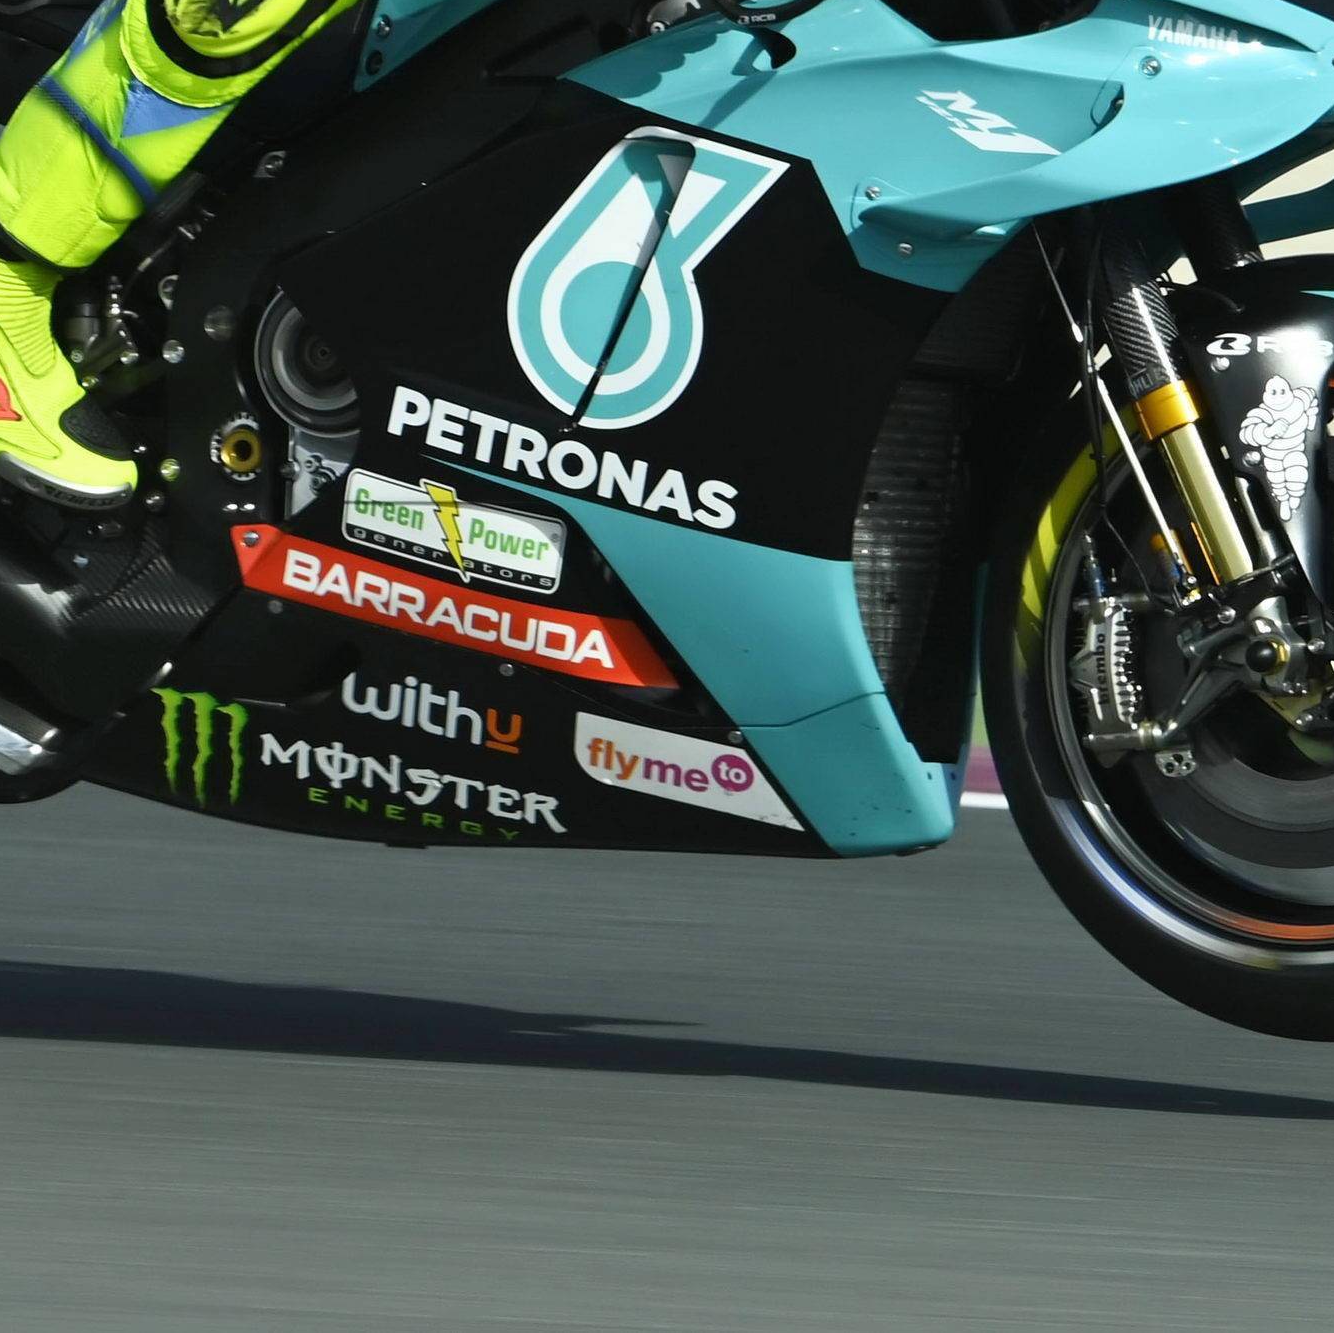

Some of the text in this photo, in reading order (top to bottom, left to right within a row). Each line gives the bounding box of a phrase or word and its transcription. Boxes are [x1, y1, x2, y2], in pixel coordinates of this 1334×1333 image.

[1148, 14, 1240, 54] YAMAHA
[387, 386, 738, 530] PETRONAS
[354, 487, 549, 561] Green Power
[282, 548, 615, 669] BARRACUDA
[341, 671, 523, 753] withu
[259, 732, 568, 834] MONSTER
[307, 786, 521, 840] ENERGY
